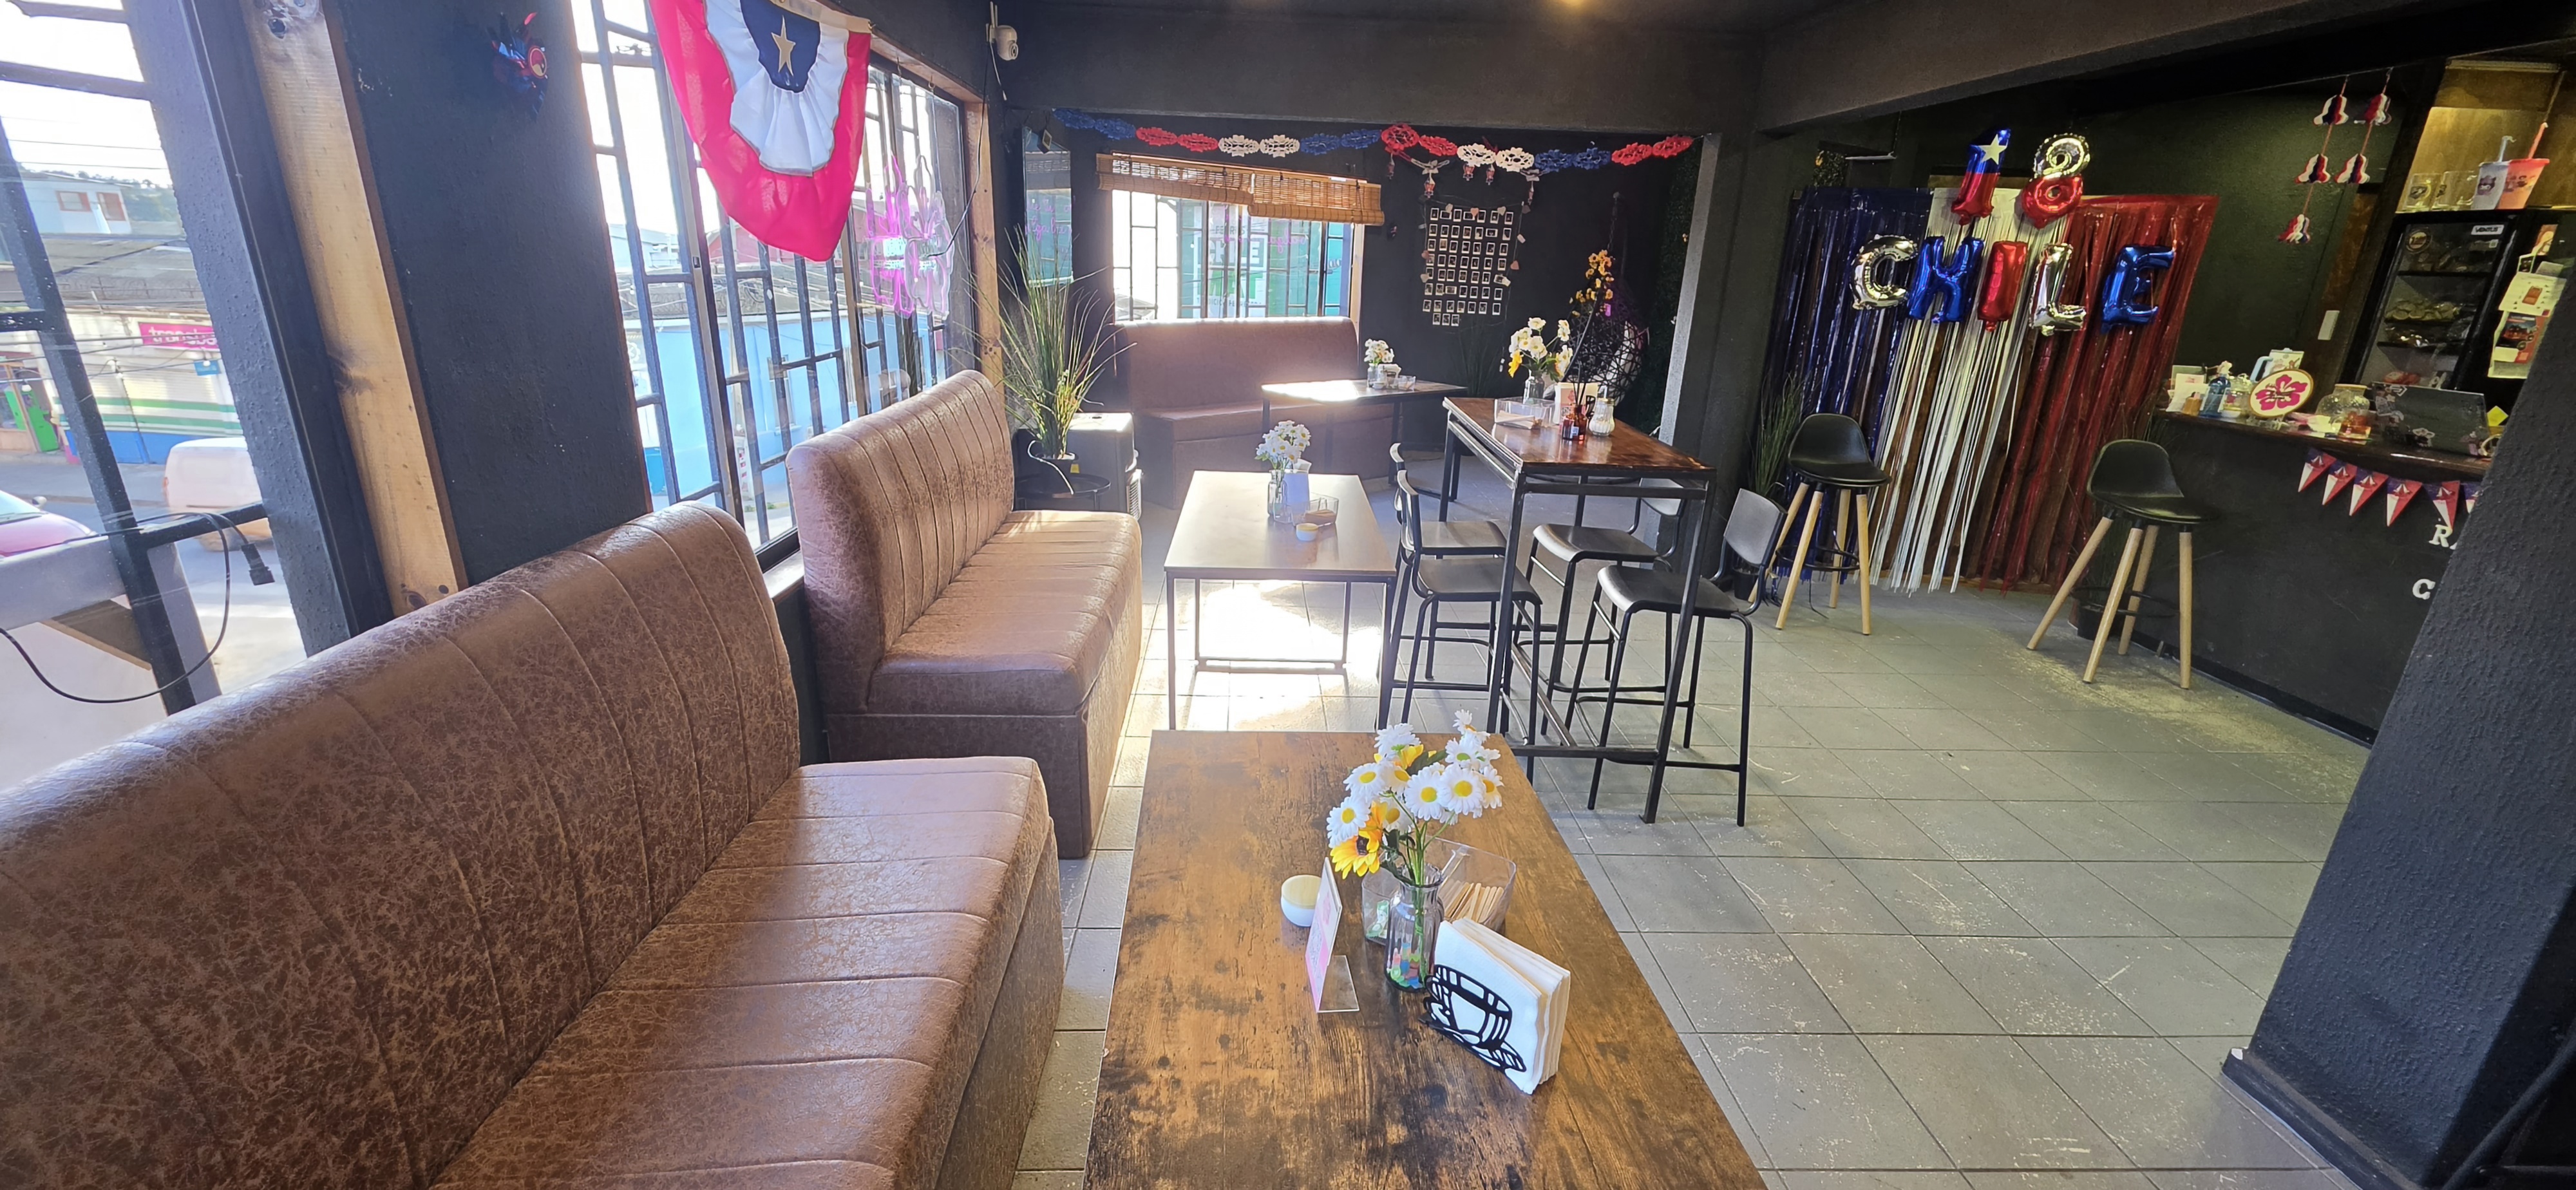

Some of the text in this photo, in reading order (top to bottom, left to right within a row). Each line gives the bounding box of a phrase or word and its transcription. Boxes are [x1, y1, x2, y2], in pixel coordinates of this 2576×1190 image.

[1951, 128, 2090, 229] 18
[1850, 234, 2175, 334] CHILE
[149, 326, 217, 345] transba
[2429, 524, 2458, 550] R
